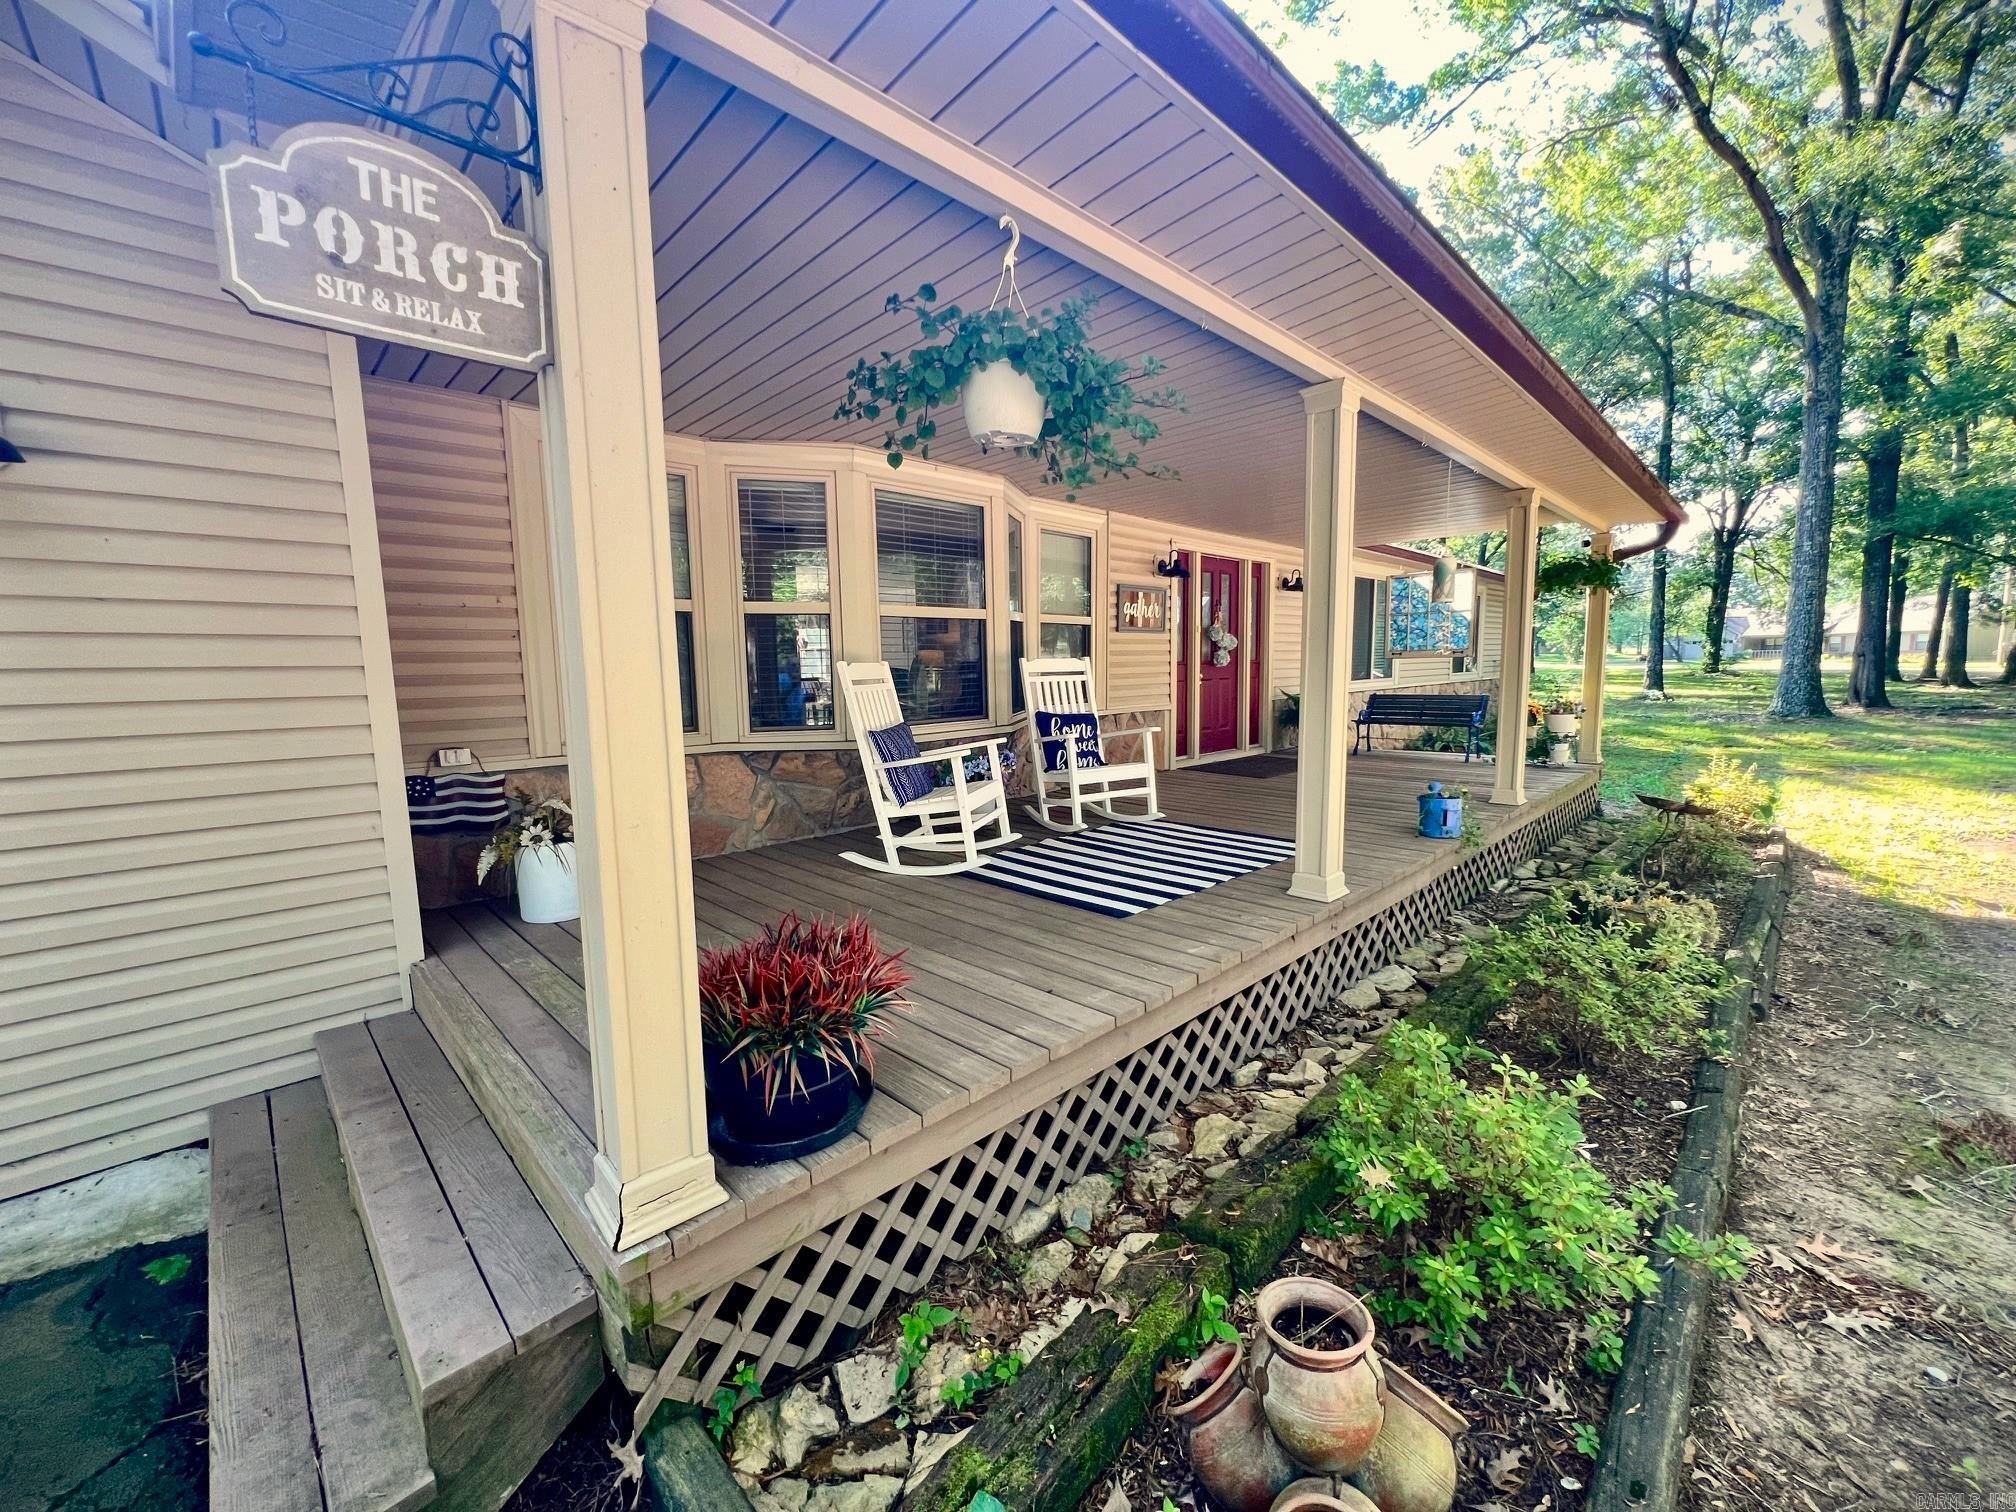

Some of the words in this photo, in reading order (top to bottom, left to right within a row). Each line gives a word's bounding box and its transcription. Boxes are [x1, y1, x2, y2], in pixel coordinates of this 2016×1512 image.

[347, 156, 440, 222] THE
[250, 184, 525, 309] PORCH
[316, 273, 367, 307] SIT
[371, 287, 391, 313] &
[395, 292, 486, 335] RELAX
[1123, 598, 1161, 623] gather
[1051, 717, 1095, 739] home
